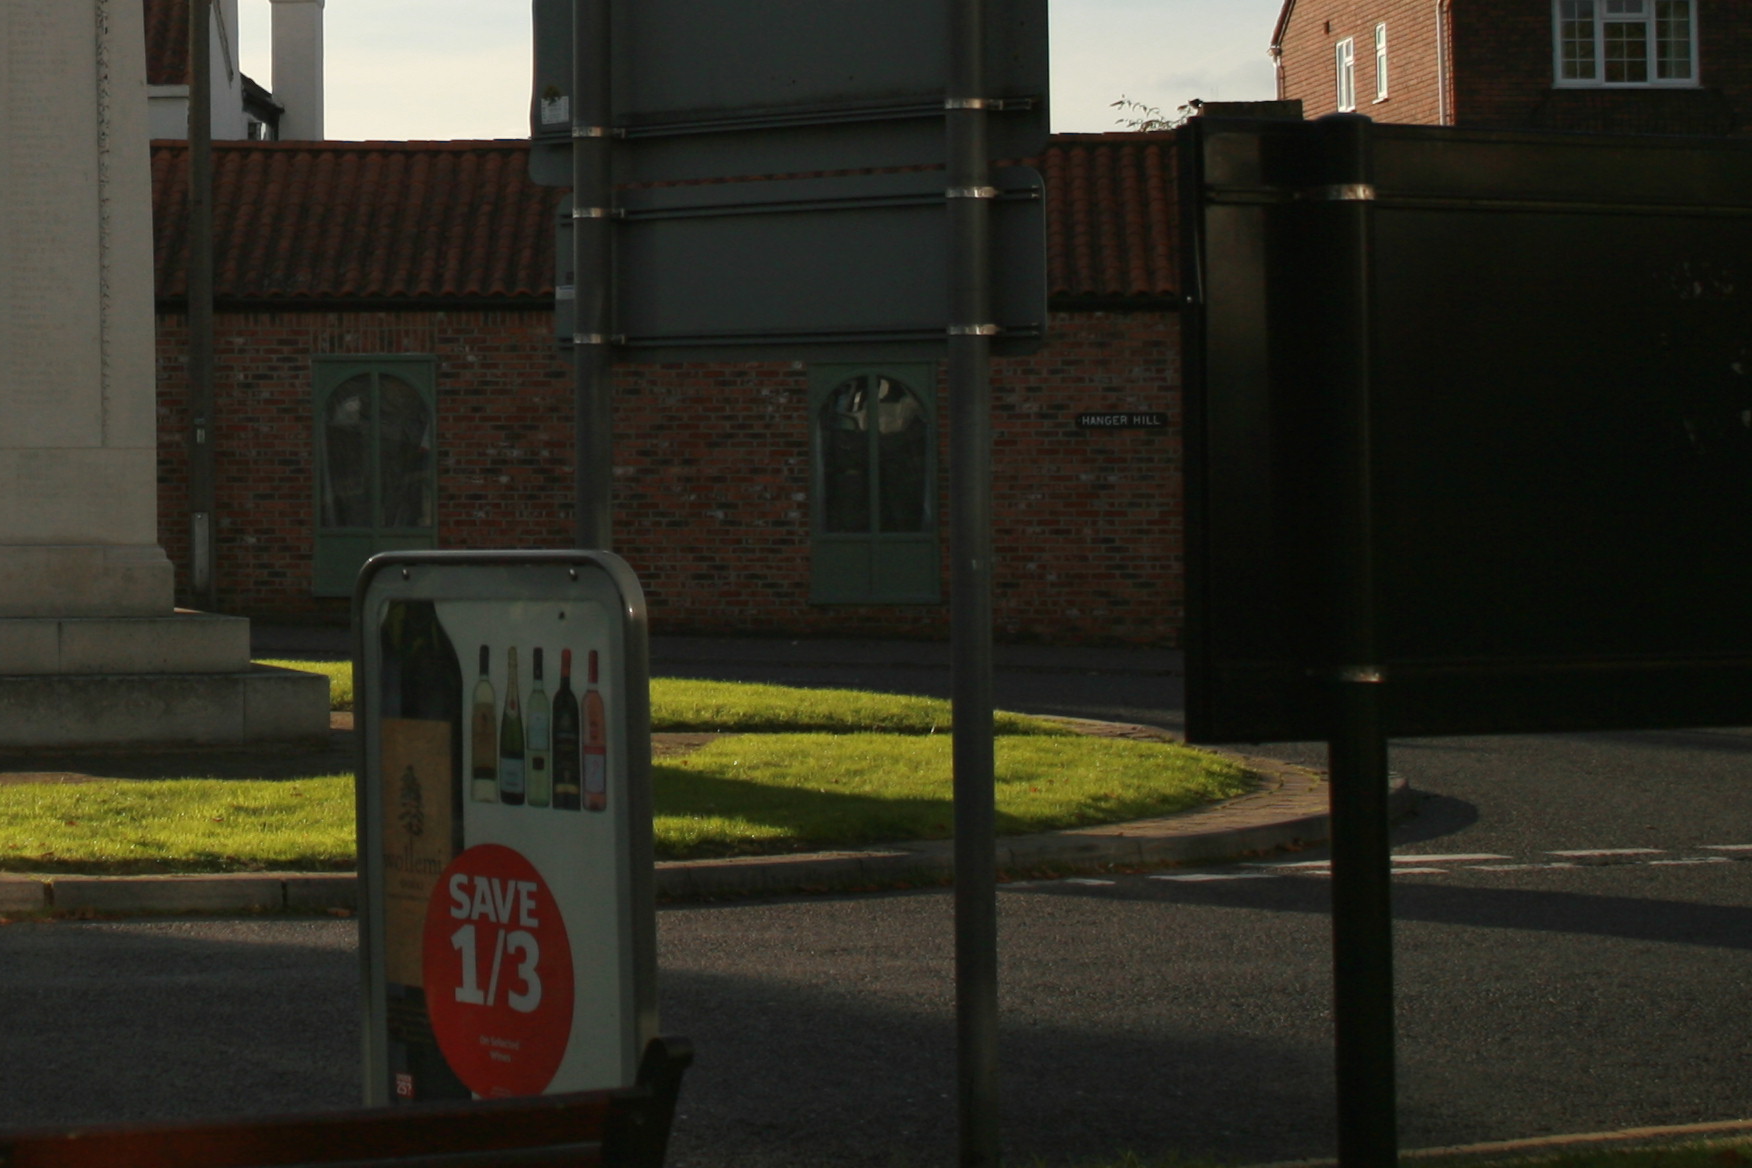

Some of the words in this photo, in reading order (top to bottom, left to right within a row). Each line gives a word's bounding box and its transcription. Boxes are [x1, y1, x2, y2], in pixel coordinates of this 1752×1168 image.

[1082, 416, 1128, 425] HANGER
[1133, 416, 1160, 425] HILL
[449, 873, 538, 928] SAVE
[450, 924, 542, 1013] 1/3
